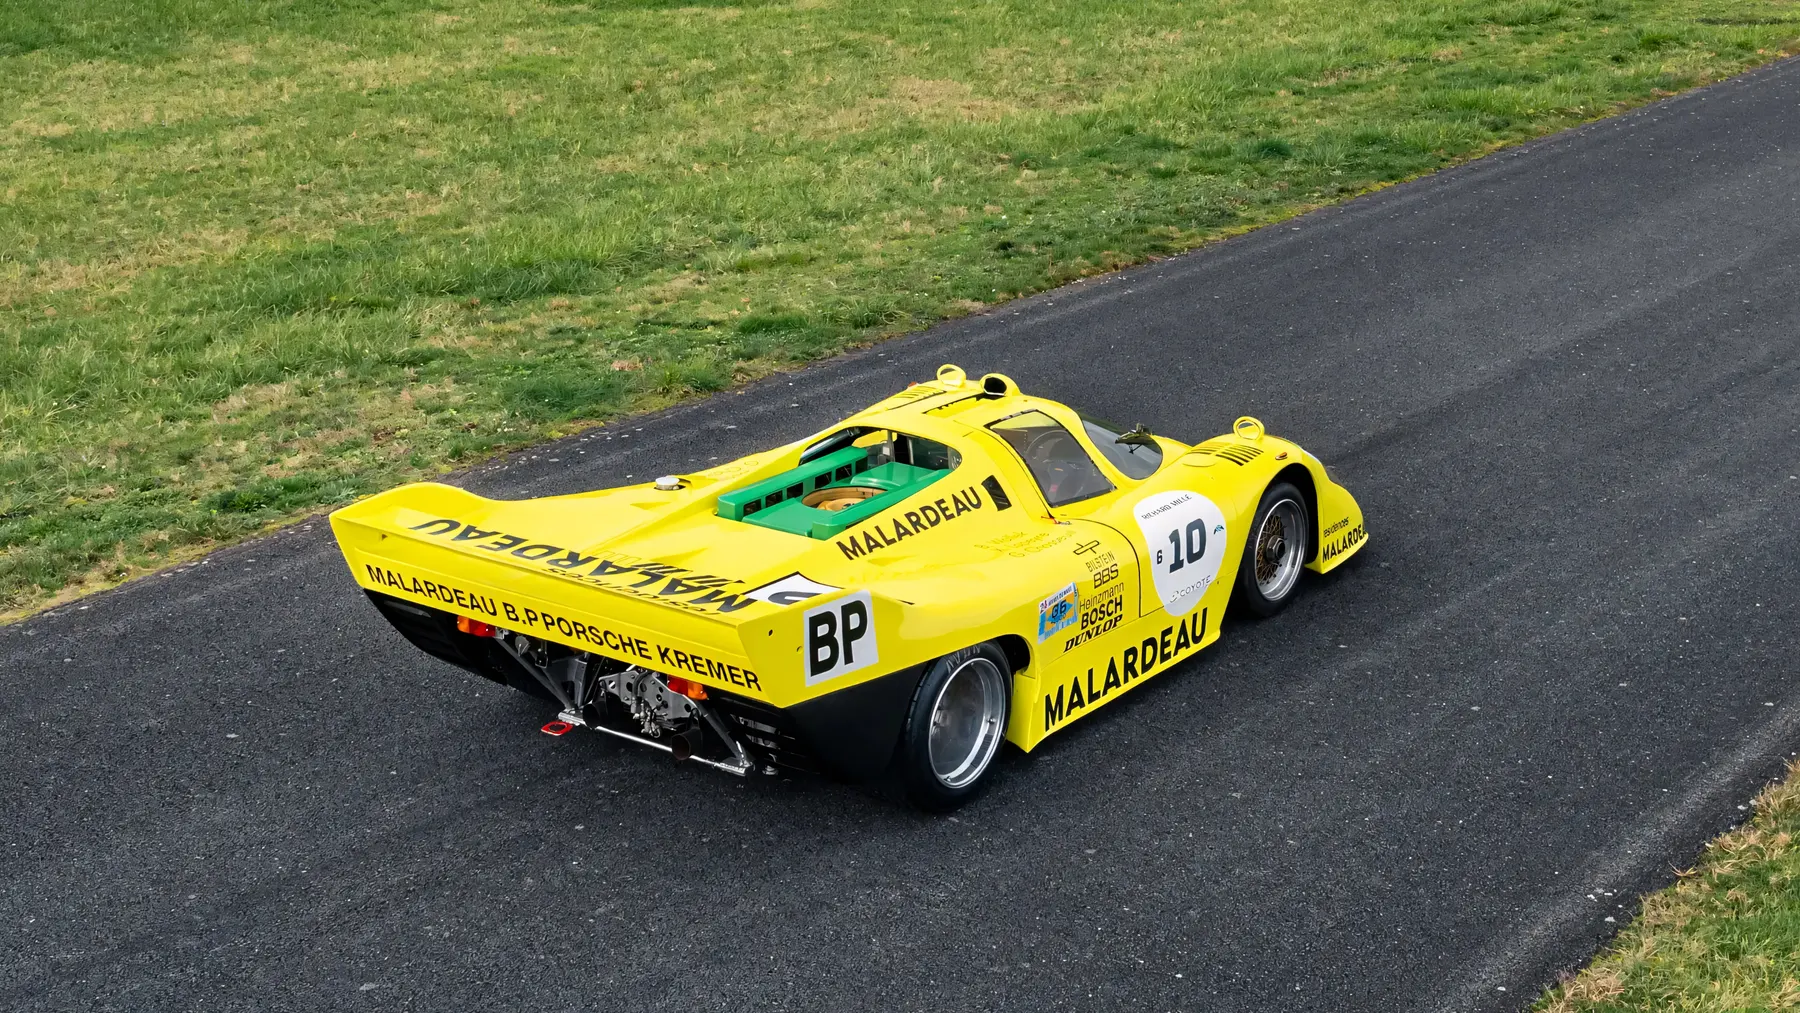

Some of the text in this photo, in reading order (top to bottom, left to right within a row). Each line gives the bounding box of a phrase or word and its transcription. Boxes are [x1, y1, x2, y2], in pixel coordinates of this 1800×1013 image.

[1171, 494, 1193, 507] MILLE
[836, 486, 983, 561] MALARDEAU
[1085, 551, 1116, 573] BILSTEIN
[1156, 549, 1163, 565] 6
[1169, 518, 1207, 574] 10
[408, 519, 758, 613] MALARDEAU
[1093, 563, 1119, 589] BBS
[1079, 581, 1125, 613] Heinzmann
[1180, 575, 1211, 598] COYOTE
[1051, 599, 1067, 619] G6
[1081, 595, 1123, 630] BOSCH
[366, 564, 498, 617] MALARDEAU
[545, 613, 652, 661] PORSCHE
[657, 645, 762, 692] KREMER
[808, 600, 868, 677] BP
[1063, 614, 1123, 653] DUNLOP
[1045, 607, 1208, 732] MALARDEAU
